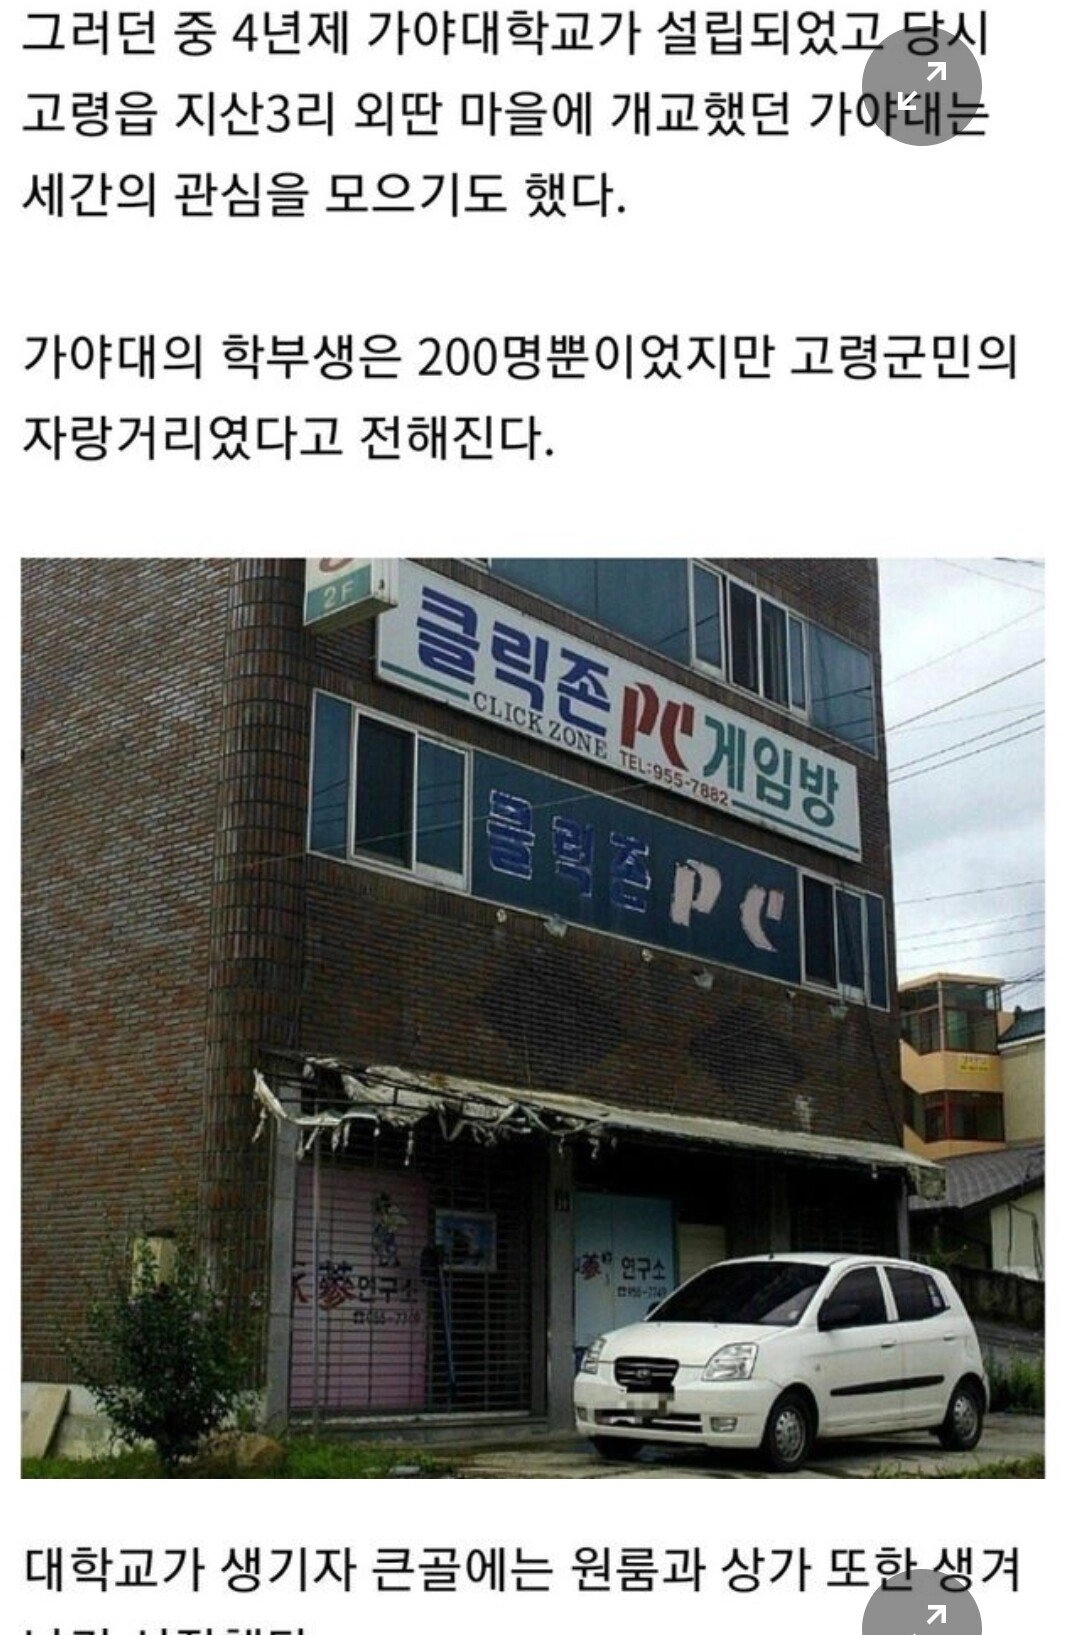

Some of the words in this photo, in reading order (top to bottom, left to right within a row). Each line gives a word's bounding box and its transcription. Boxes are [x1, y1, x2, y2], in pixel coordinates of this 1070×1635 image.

[322, 580, 355, 607] 2F
[416, 586, 612, 738] 클릭존
[703, 714, 839, 828] 게임방
[473, 690, 545, 734] CLICK
[547, 719, 610, 760] ZONE
[486, 788, 652, 914] 클릭존
[621, 1255, 667, 1281] 연구소
